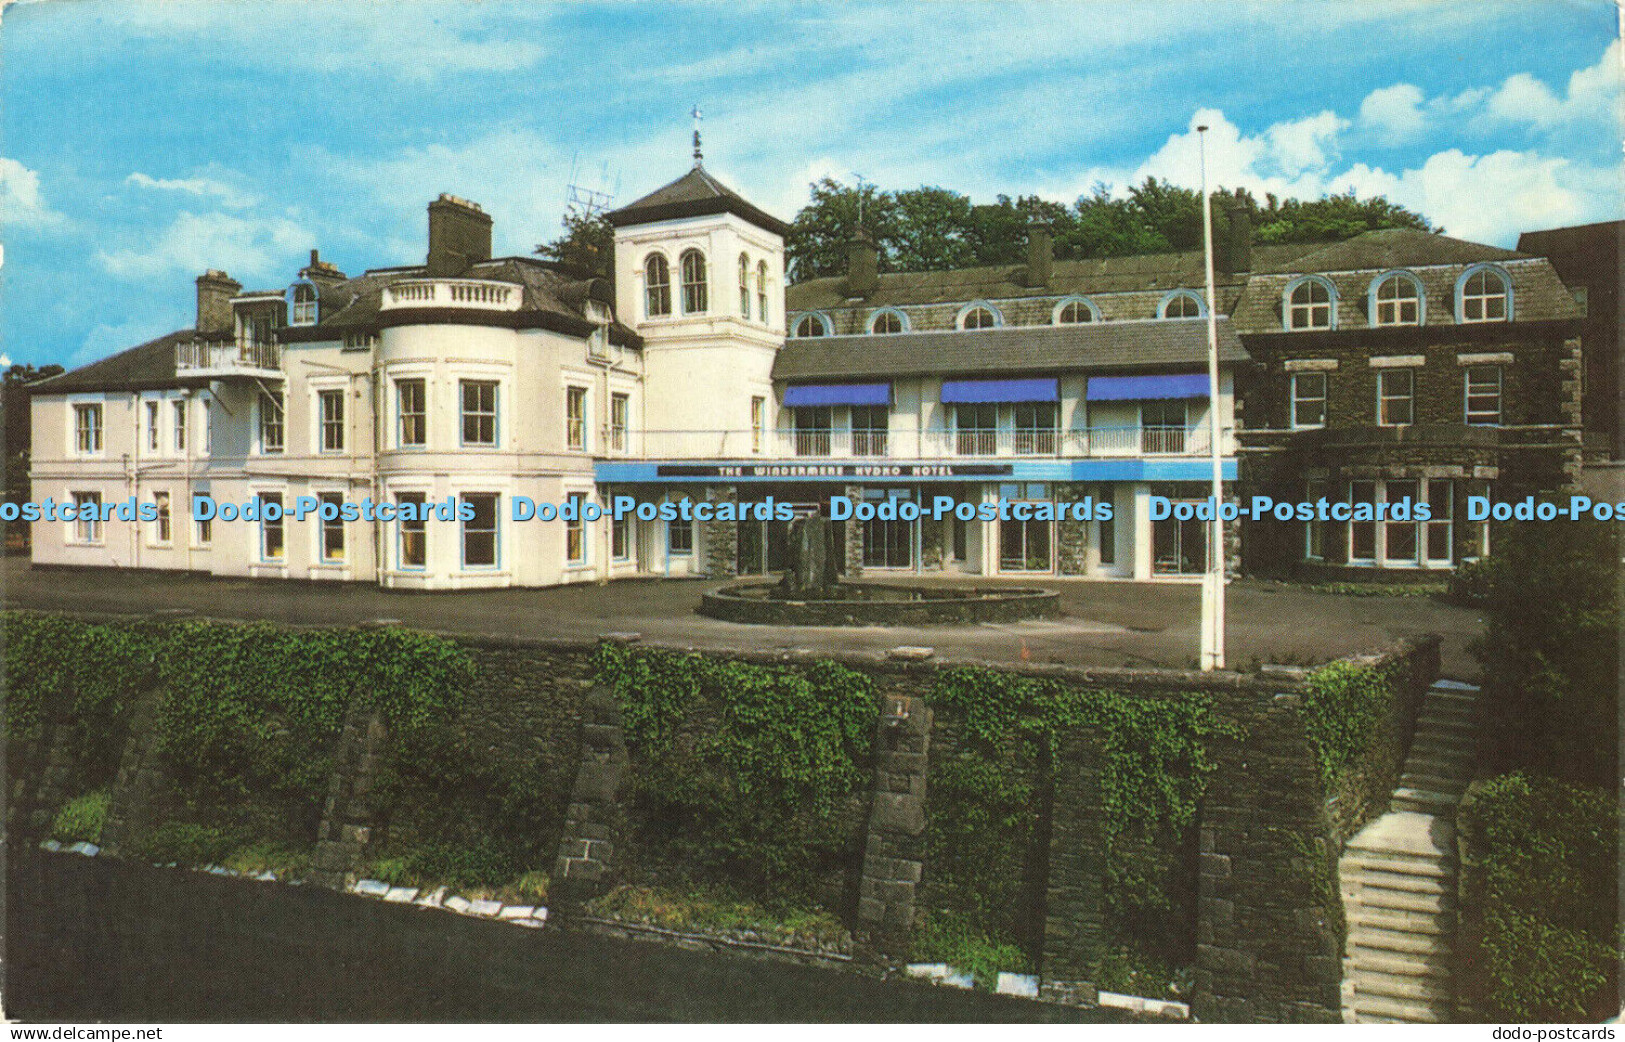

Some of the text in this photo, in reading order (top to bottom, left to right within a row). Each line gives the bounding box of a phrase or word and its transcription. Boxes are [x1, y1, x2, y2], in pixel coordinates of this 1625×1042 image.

[719, 466, 953, 476] THE WINDERMERE HYDRO HOTEL
